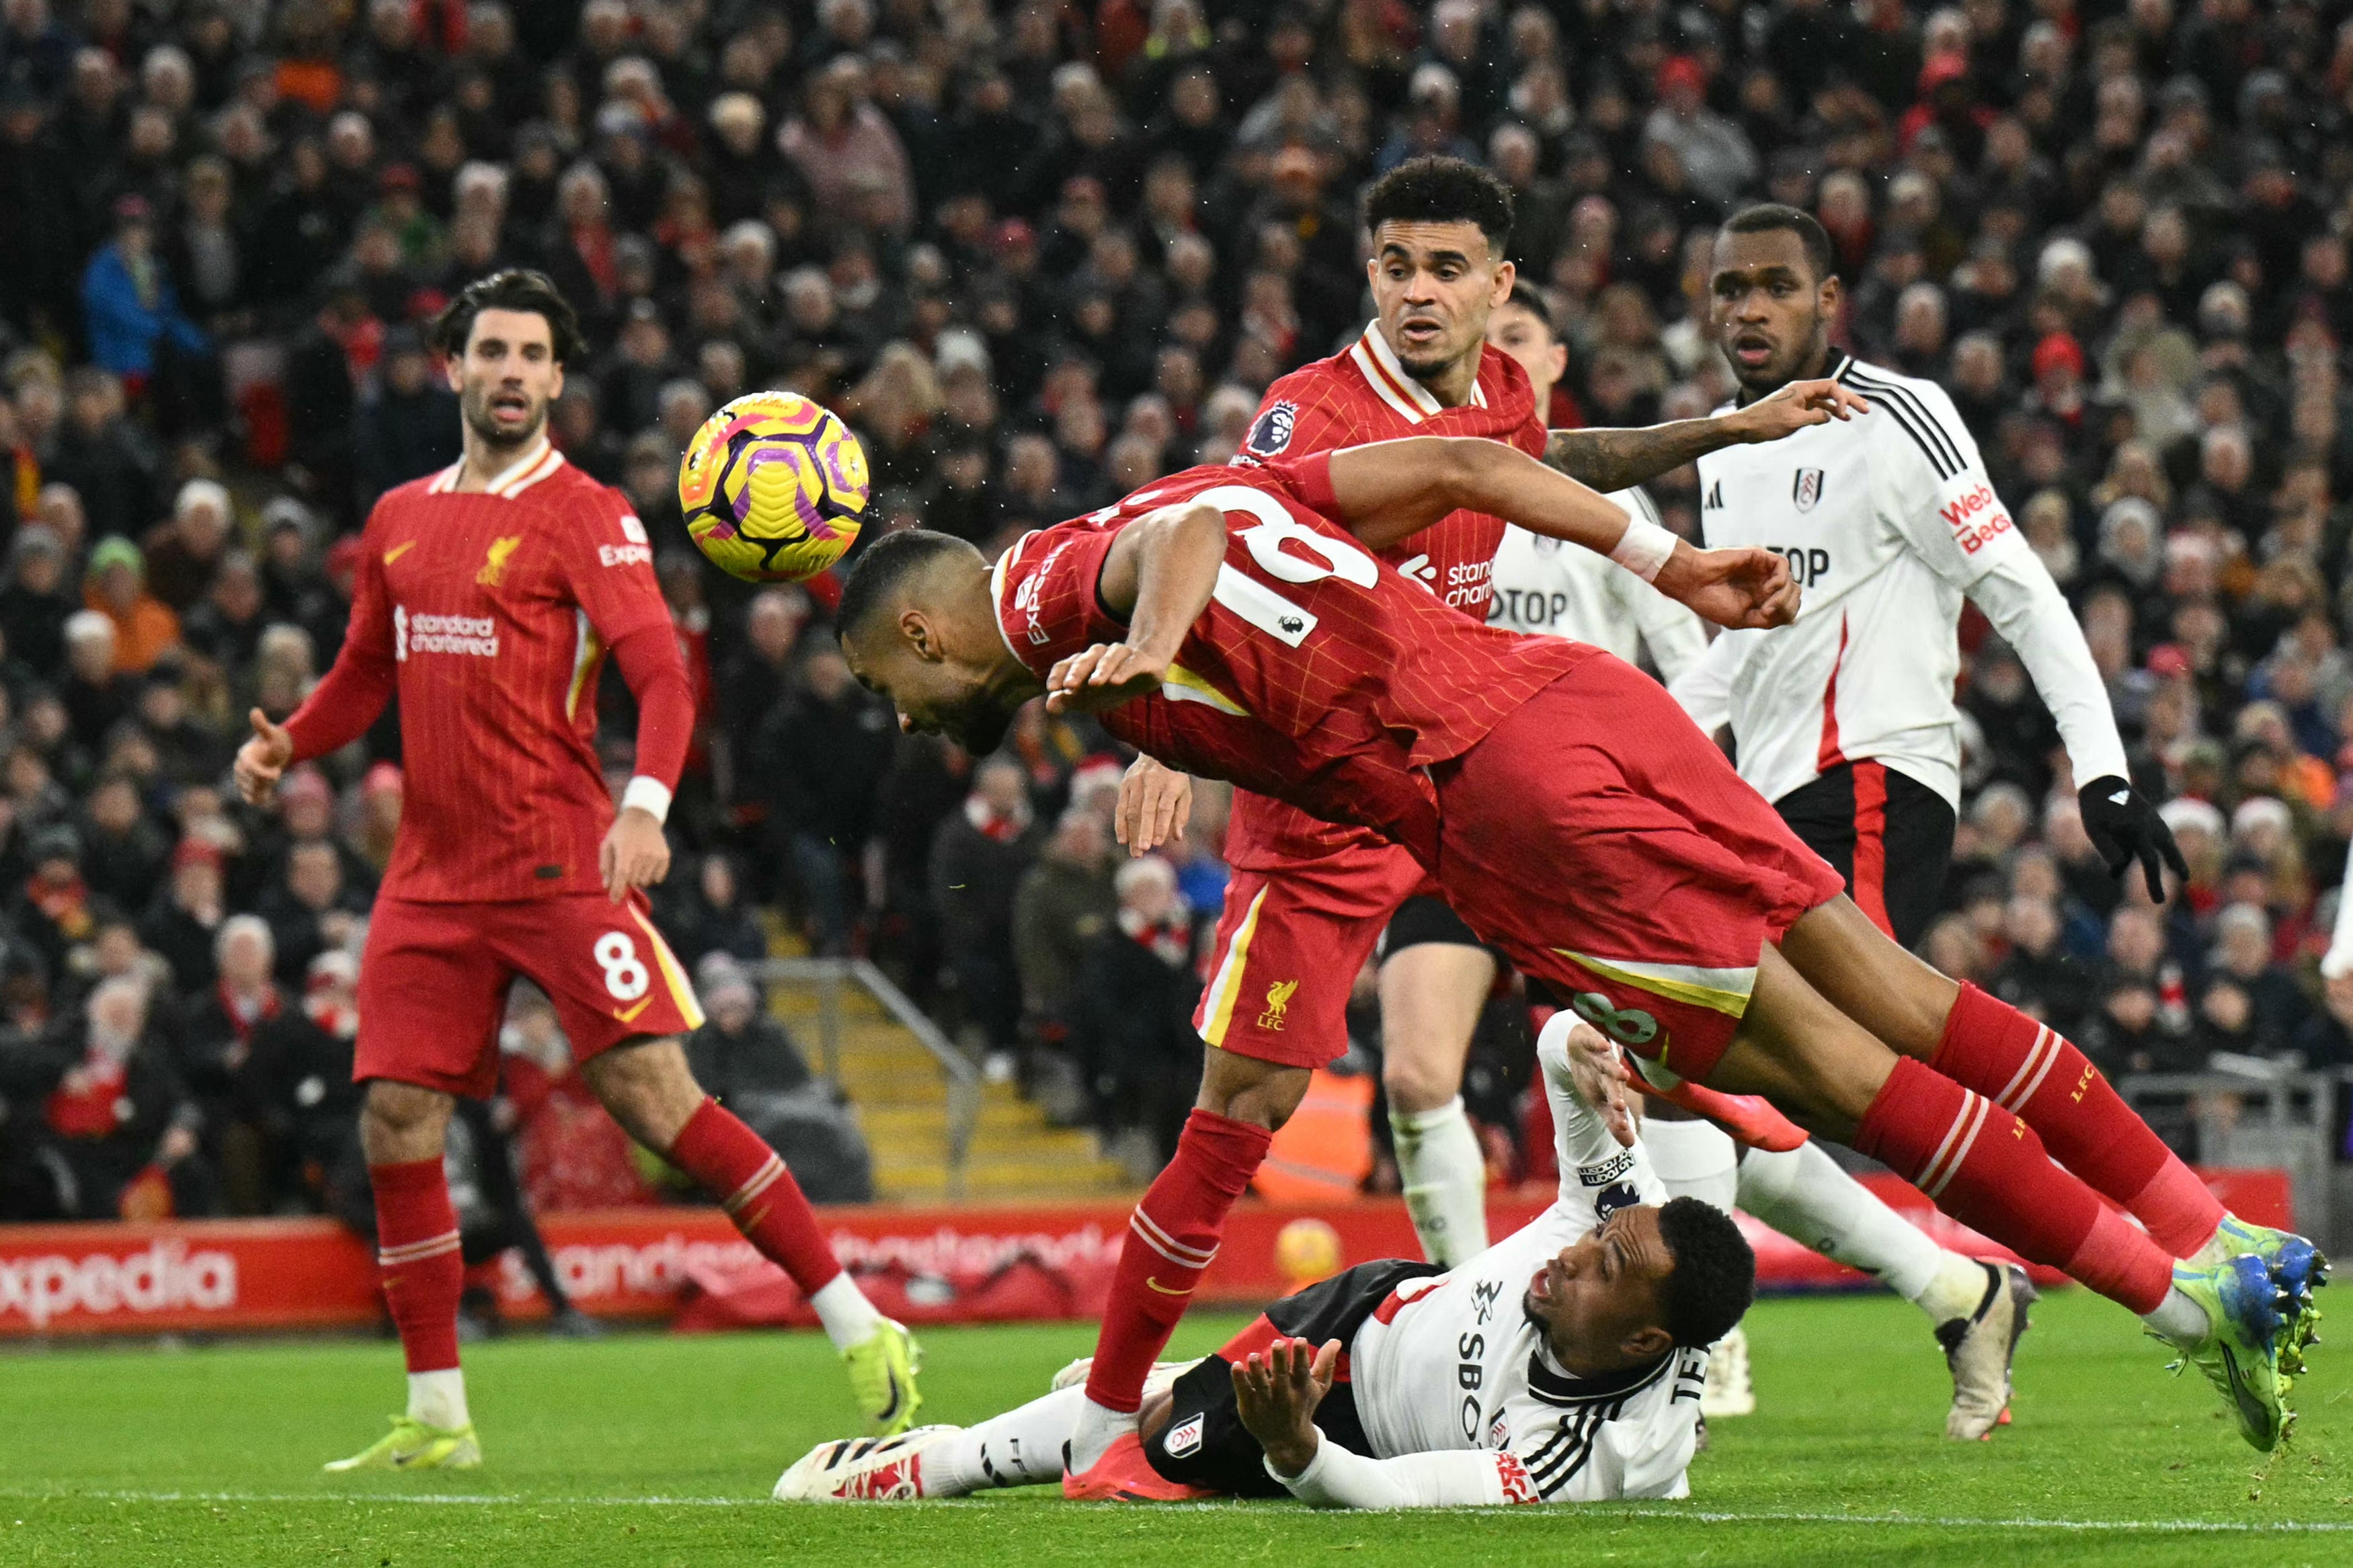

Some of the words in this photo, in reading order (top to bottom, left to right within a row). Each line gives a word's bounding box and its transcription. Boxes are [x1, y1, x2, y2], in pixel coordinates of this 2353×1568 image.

[1939, 483, 1992, 526] Web
[411, 612, 494, 637] standard
[410, 634, 500, 657] chartered
[594, 931, 649, 1001] 8
[1257, 1014, 1285, 1031] LFC
[2070, 1064, 2095, 1104] LFC
[2012, 1115, 2027, 1141] LF
[1579, 1158, 1618, 1175] racism
[1586, 1166, 1620, 1184] room
[1619, 1157, 1635, 1171] No
[1670, 1346, 1712, 1407] TE
[1458, 1331, 1484, 1449] SBO
